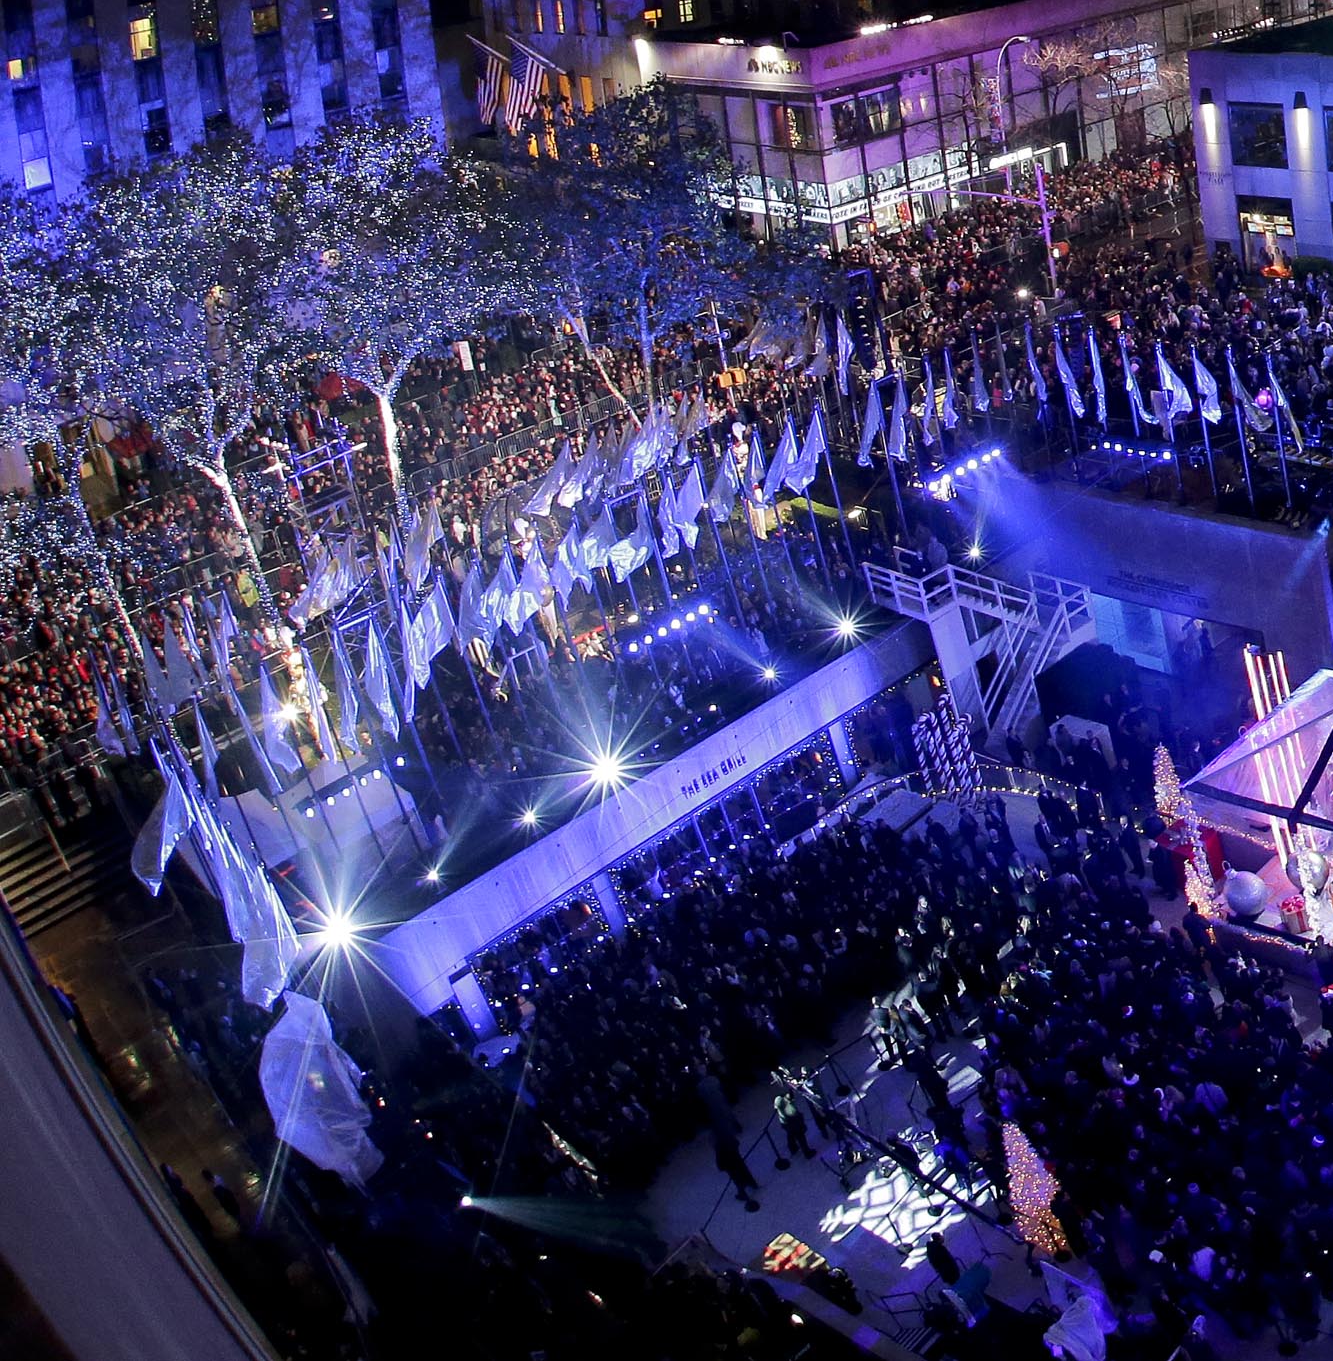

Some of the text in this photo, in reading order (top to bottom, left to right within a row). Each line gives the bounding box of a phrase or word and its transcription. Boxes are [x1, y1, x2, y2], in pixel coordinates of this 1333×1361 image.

[681, 754, 747, 799] THE SEA GRILL
